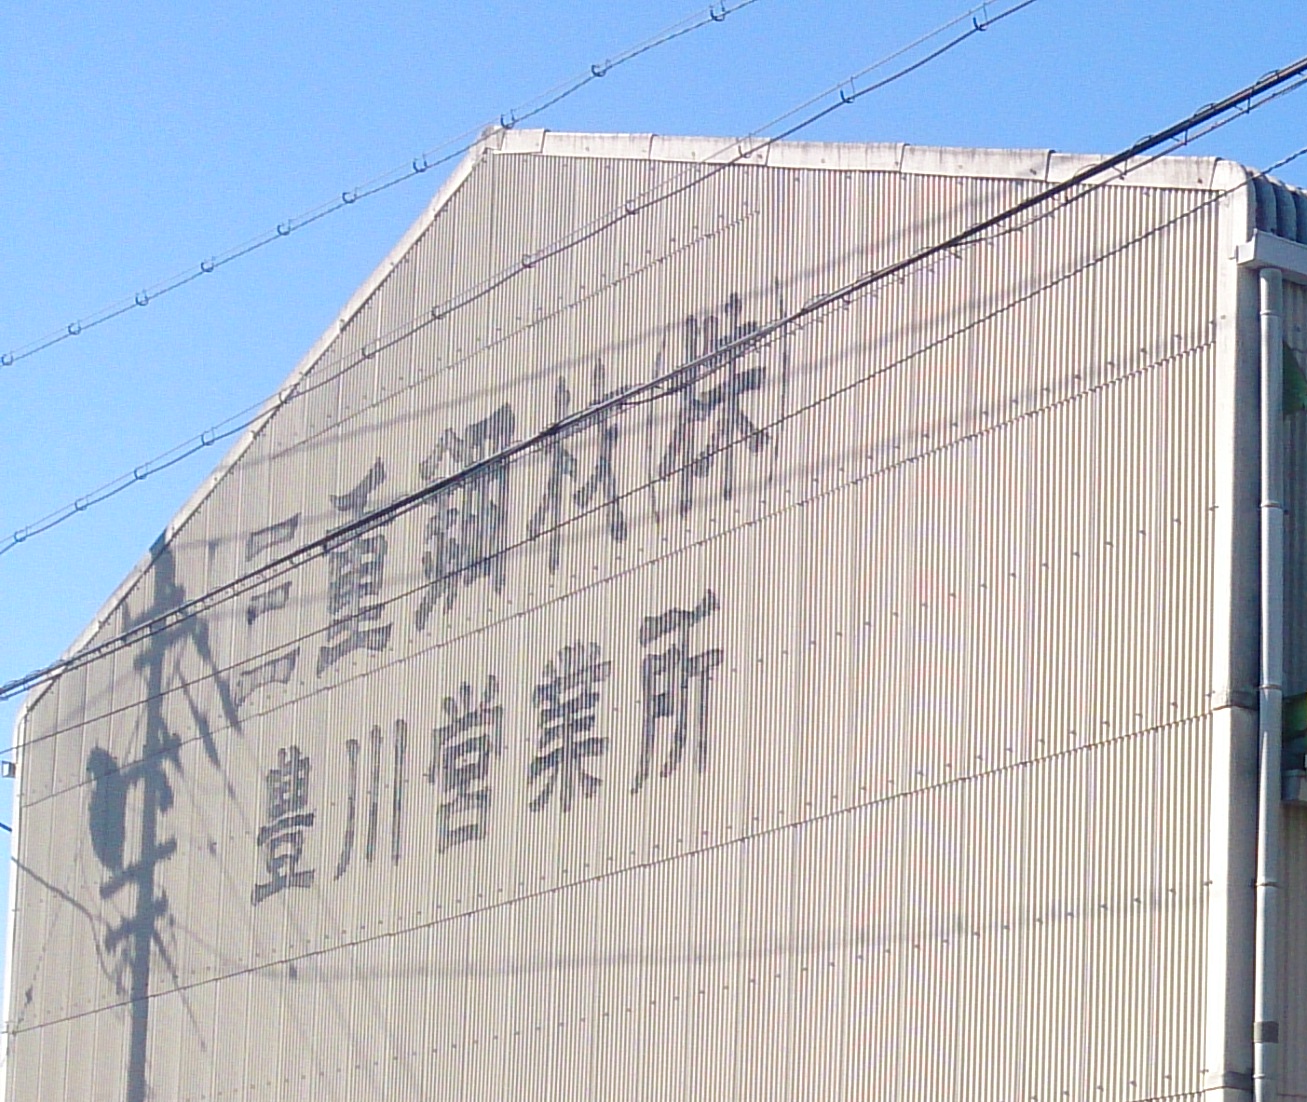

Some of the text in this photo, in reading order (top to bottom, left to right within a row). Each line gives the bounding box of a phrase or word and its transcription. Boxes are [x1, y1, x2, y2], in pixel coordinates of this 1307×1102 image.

[252, 589, 724, 905] 豊川営業所
